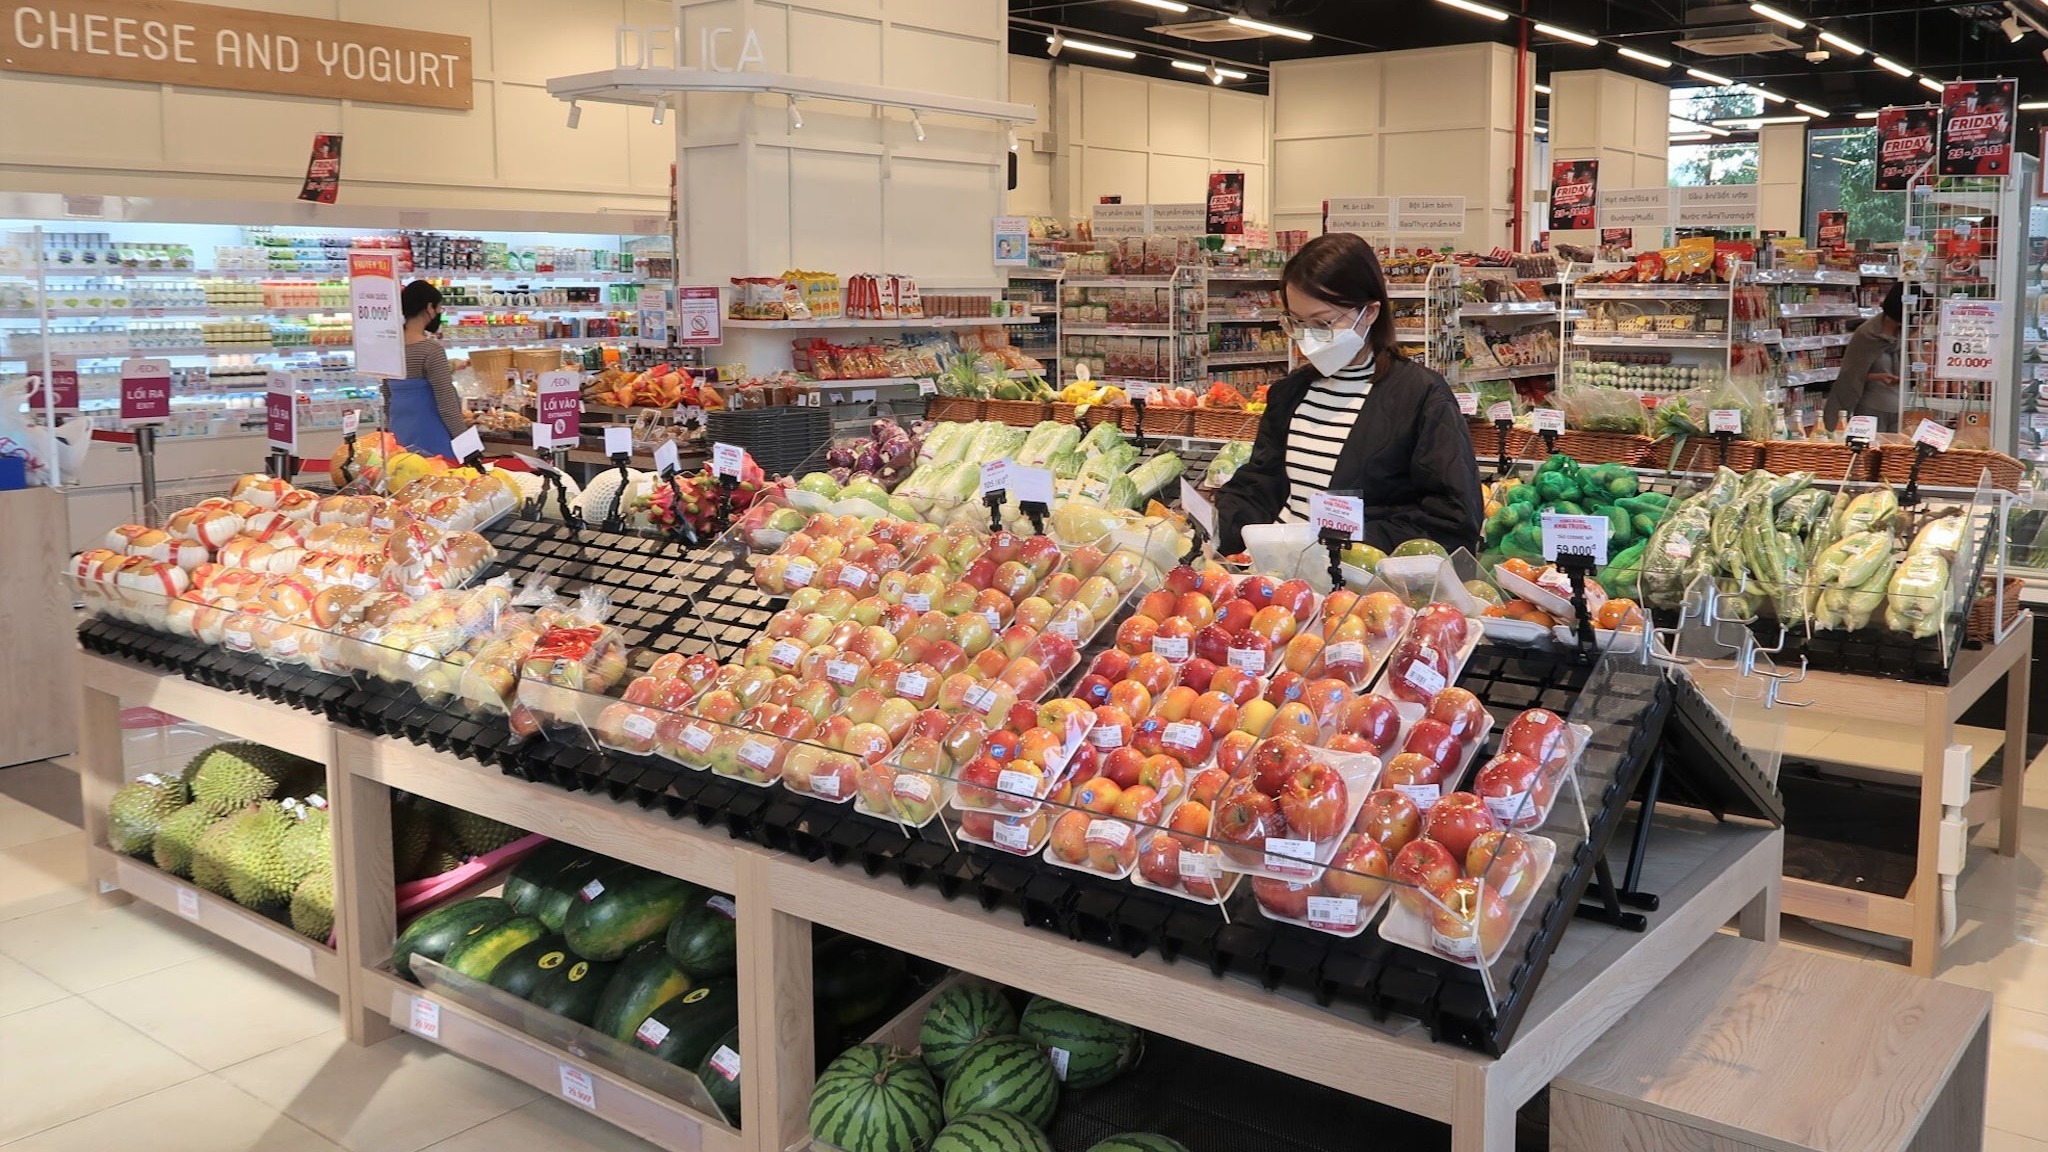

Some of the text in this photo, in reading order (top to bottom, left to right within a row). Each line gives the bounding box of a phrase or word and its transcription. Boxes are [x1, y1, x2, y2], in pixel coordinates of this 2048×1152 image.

[14, 7, 459, 88] CHEESE AND YOGURT
[615, 24, 765, 73] DELICA
[1951, 114, 2003, 130] FRIDAY
[1885, 137, 1929, 151] FRIDAY
[1557, 185, 1590, 196] FRIDAY
[1953, 342, 1971, 354] 03
[127, 387, 165, 399] LỐI RA
[543, 396, 577, 410] LỐI VÀO
